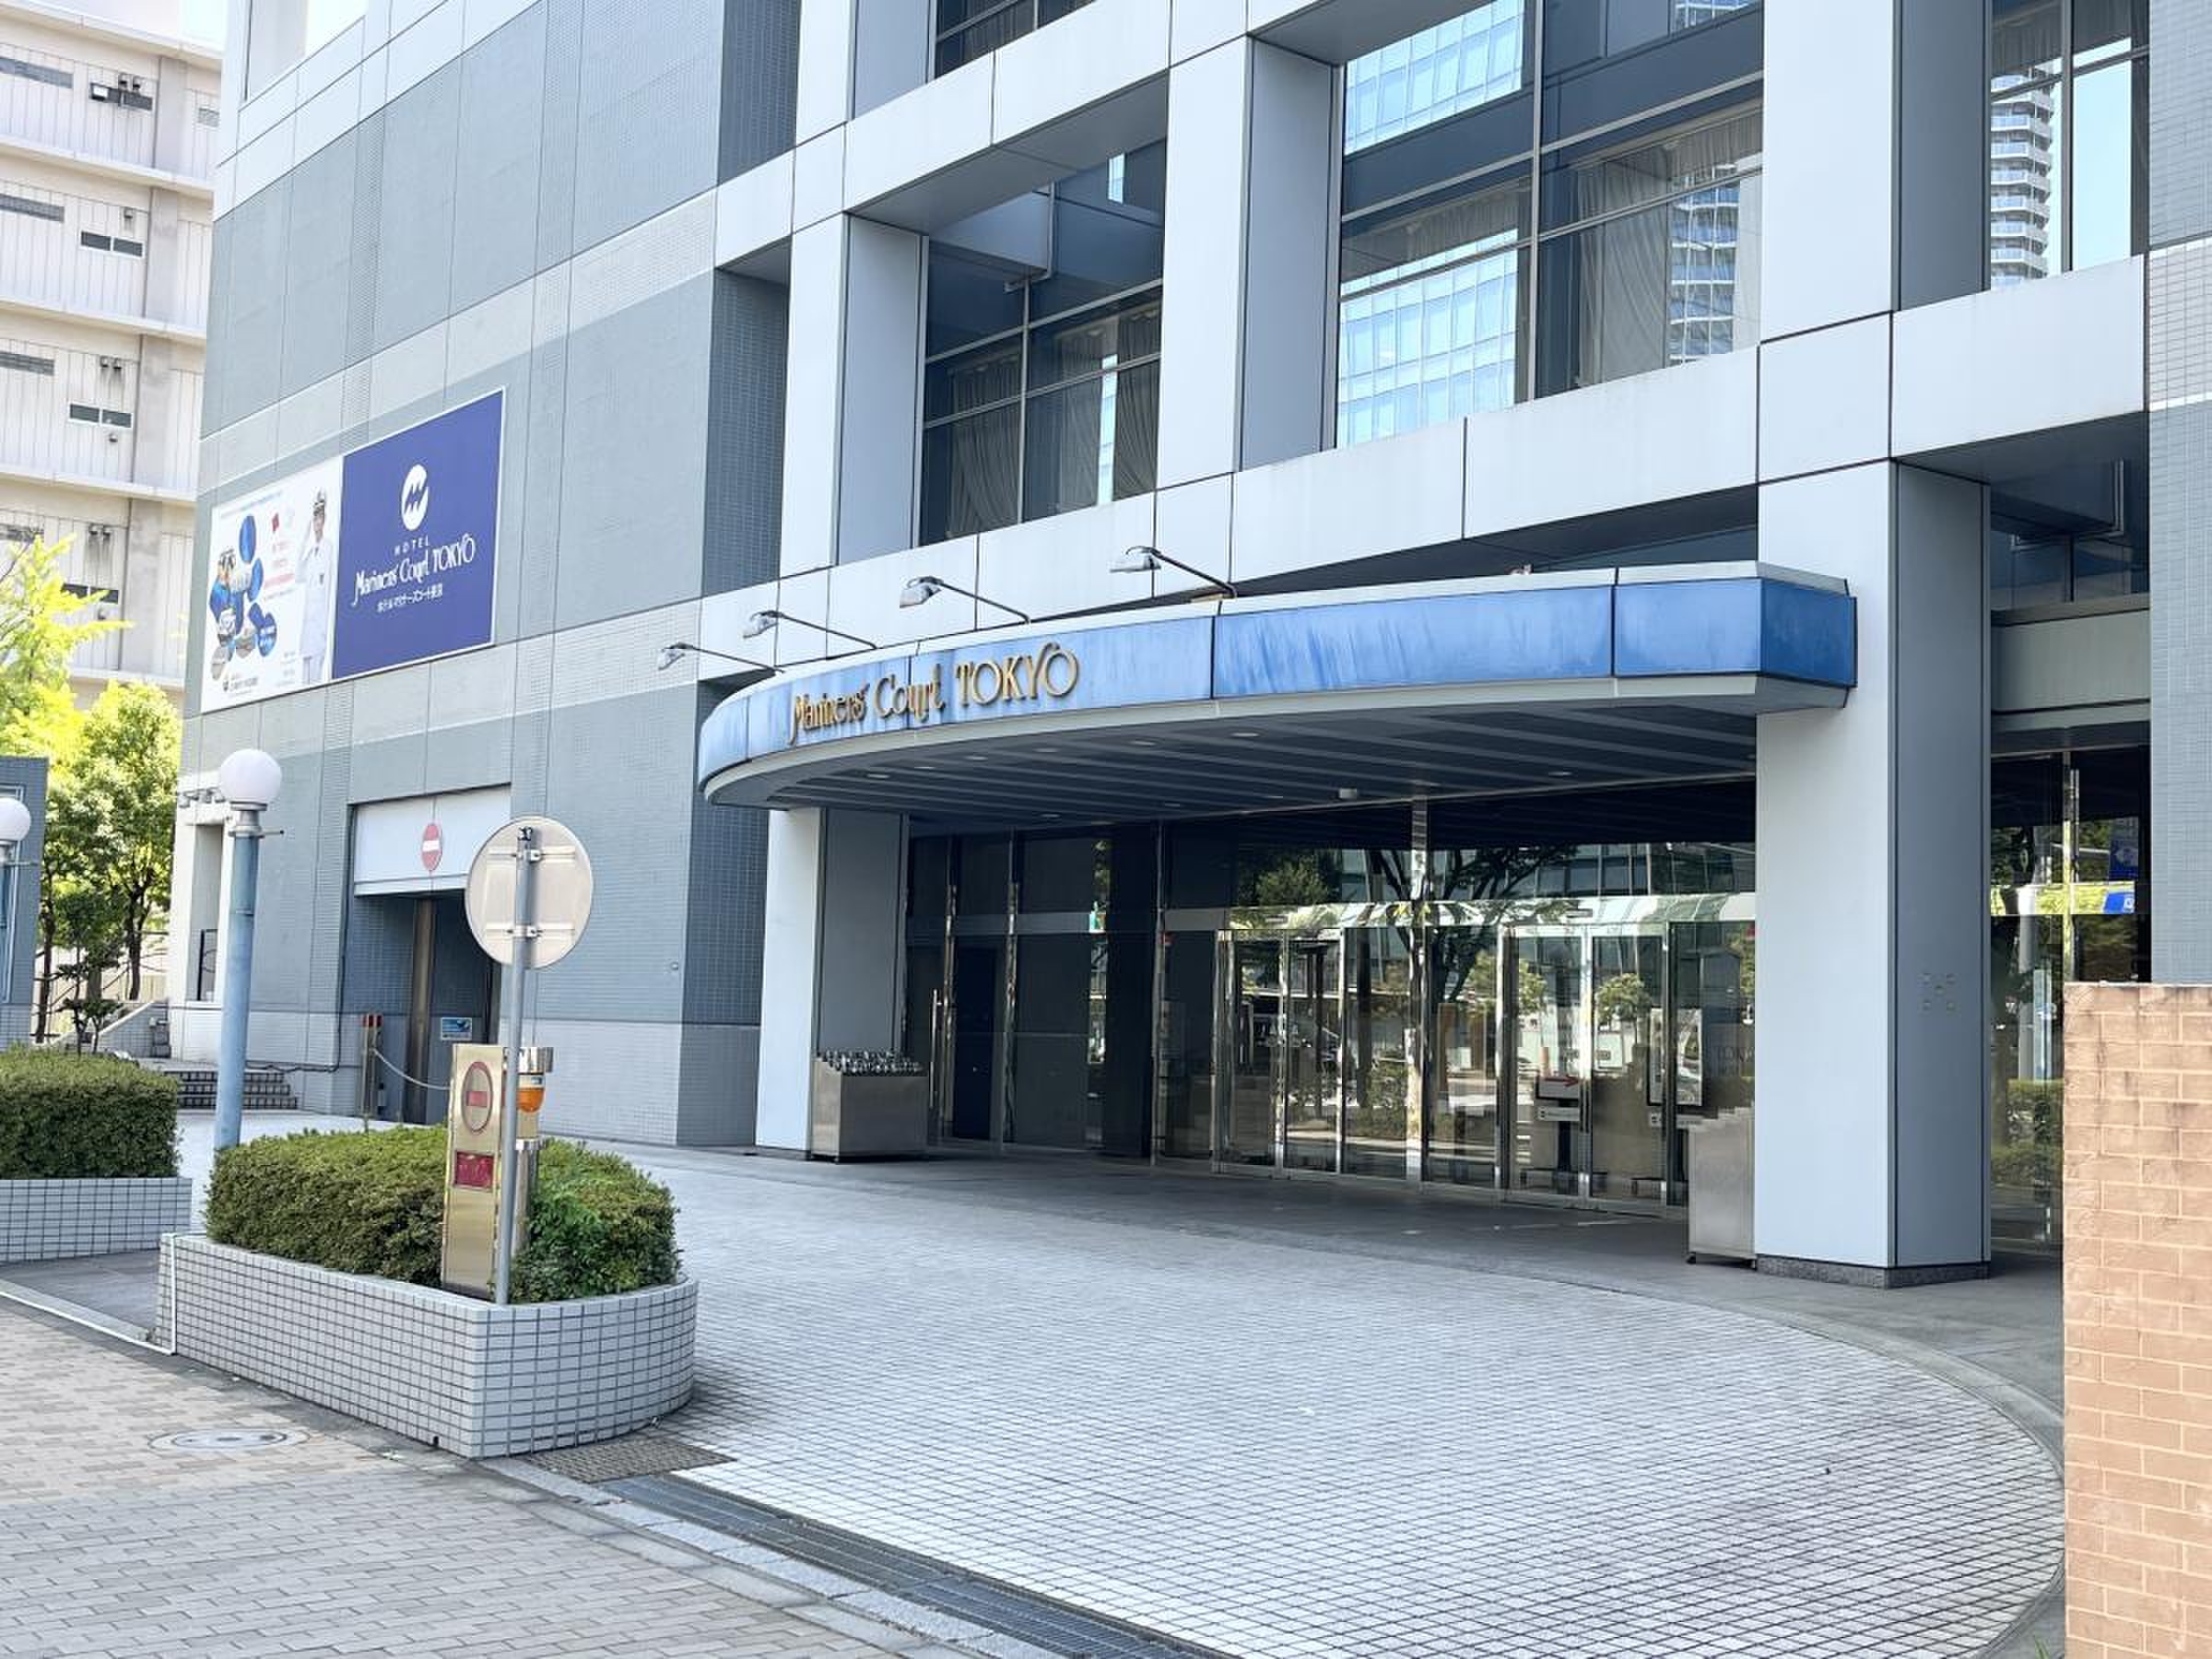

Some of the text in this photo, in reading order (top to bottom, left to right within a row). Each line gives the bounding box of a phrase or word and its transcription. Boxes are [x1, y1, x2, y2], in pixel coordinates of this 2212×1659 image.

[432, 534, 476, 572] TOKYO
[875, 662, 946, 723] Court
[956, 642, 1079, 708] TOKYO
